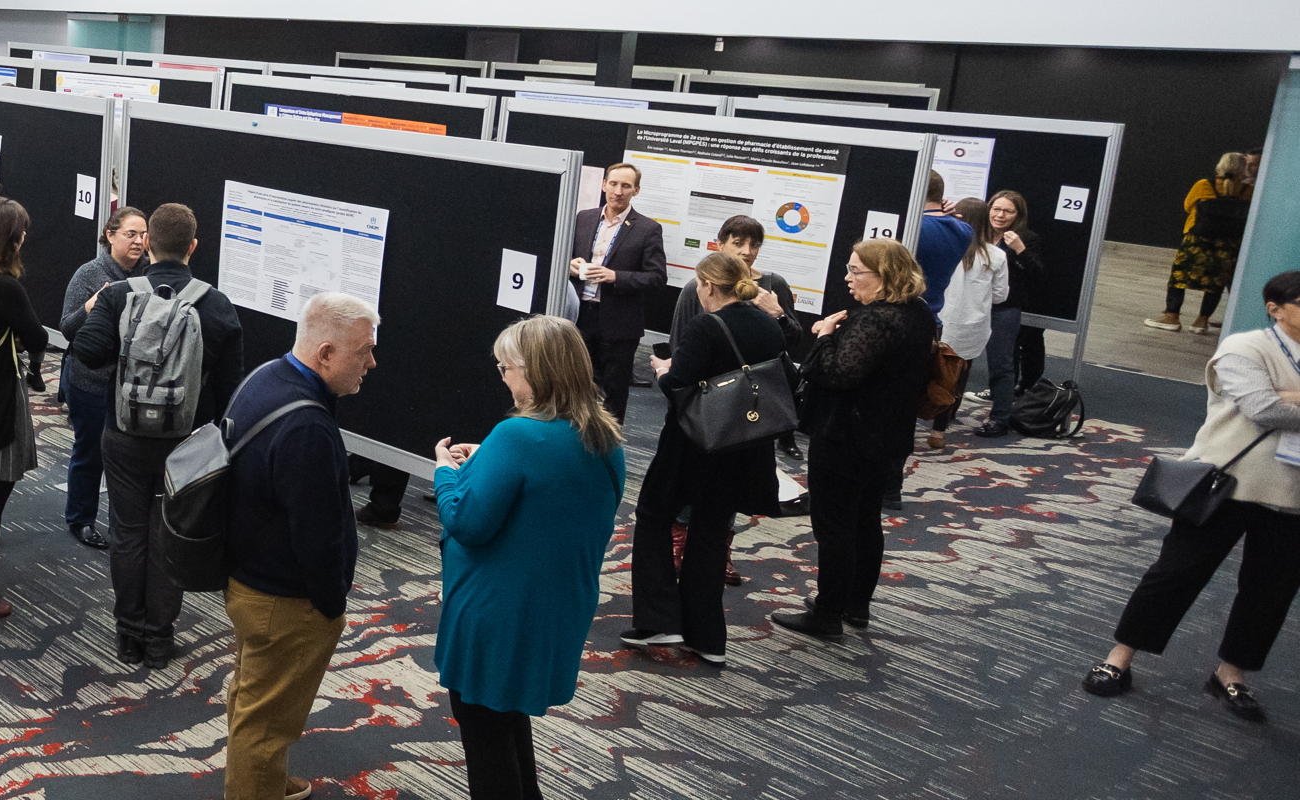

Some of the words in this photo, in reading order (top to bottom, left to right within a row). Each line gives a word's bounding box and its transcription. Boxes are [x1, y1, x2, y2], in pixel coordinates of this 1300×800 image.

[643, 130, 682, 139] Microprogramme
[771, 143, 813, 153] d'établissement
[806, 152, 837, 161] profession.
[78, 190, 91, 204] 10
[1062, 198, 1083, 210] 29
[870, 227, 892, 239] 19
[512, 272, 524, 289] 9
